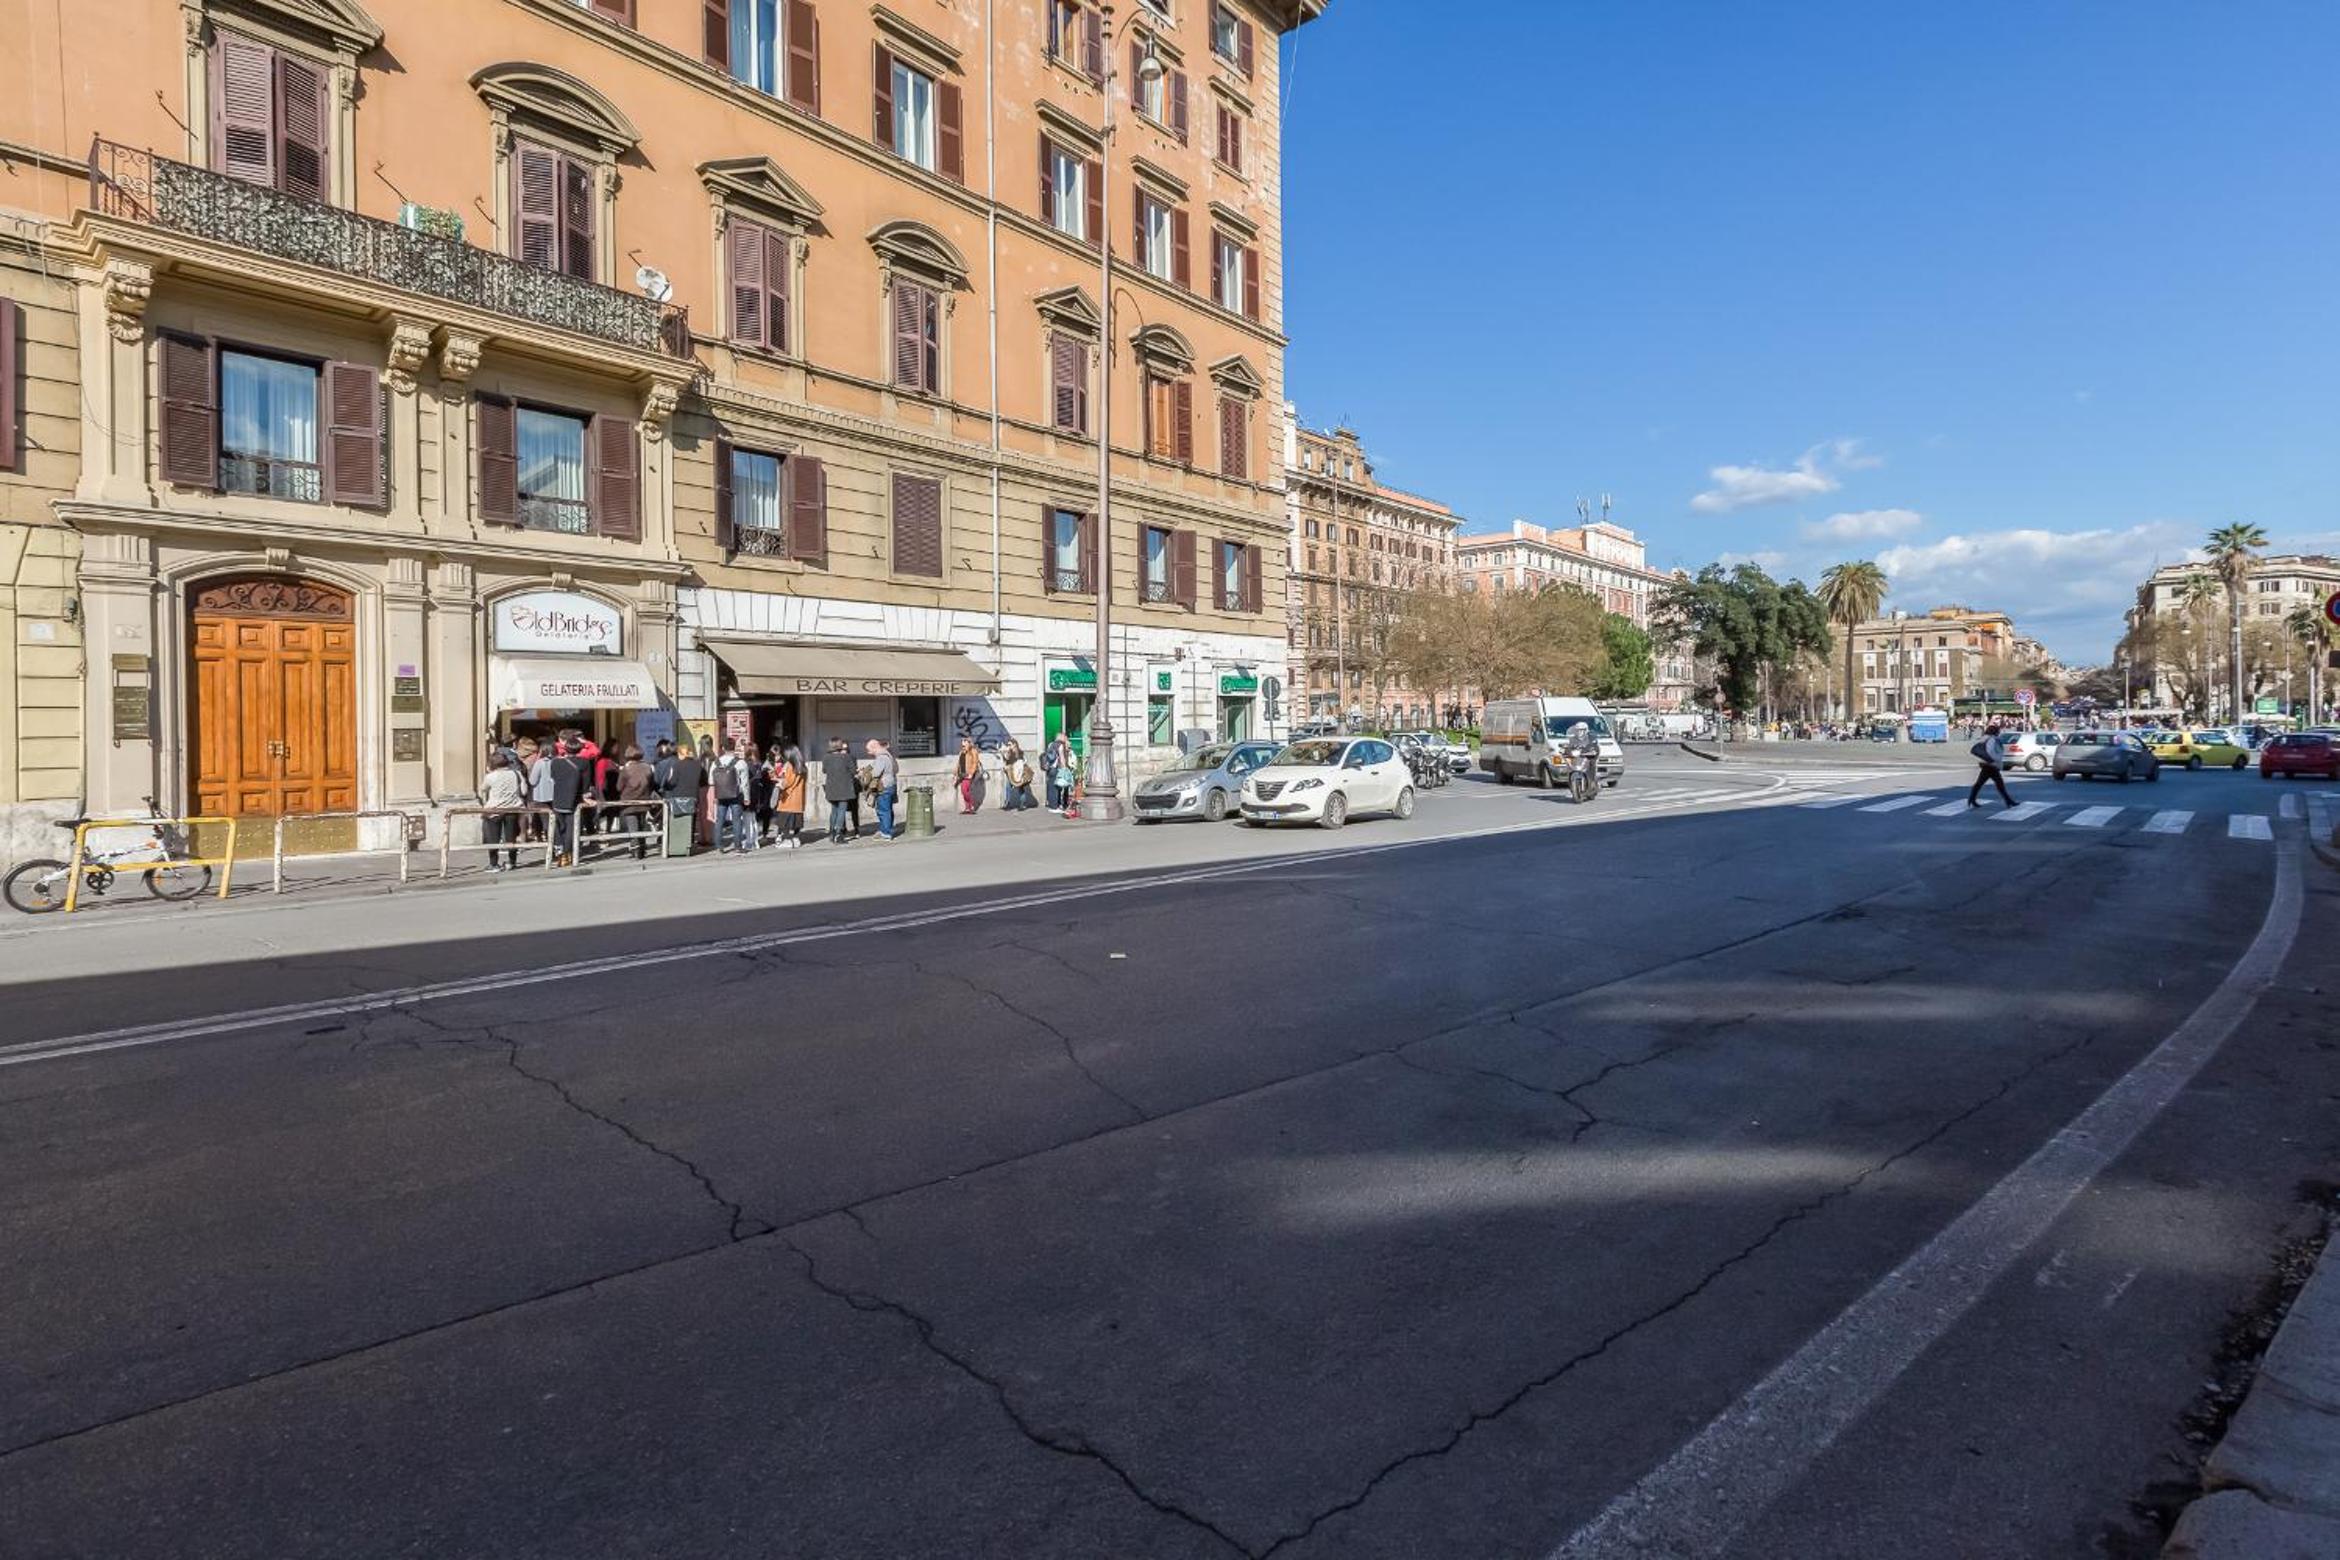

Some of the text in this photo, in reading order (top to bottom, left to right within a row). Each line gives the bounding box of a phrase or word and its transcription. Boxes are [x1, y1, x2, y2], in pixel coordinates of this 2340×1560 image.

[540, 683, 639, 697] GELATERIA FRULLATI
[796, 679, 961, 695] BAR CREPERIE
